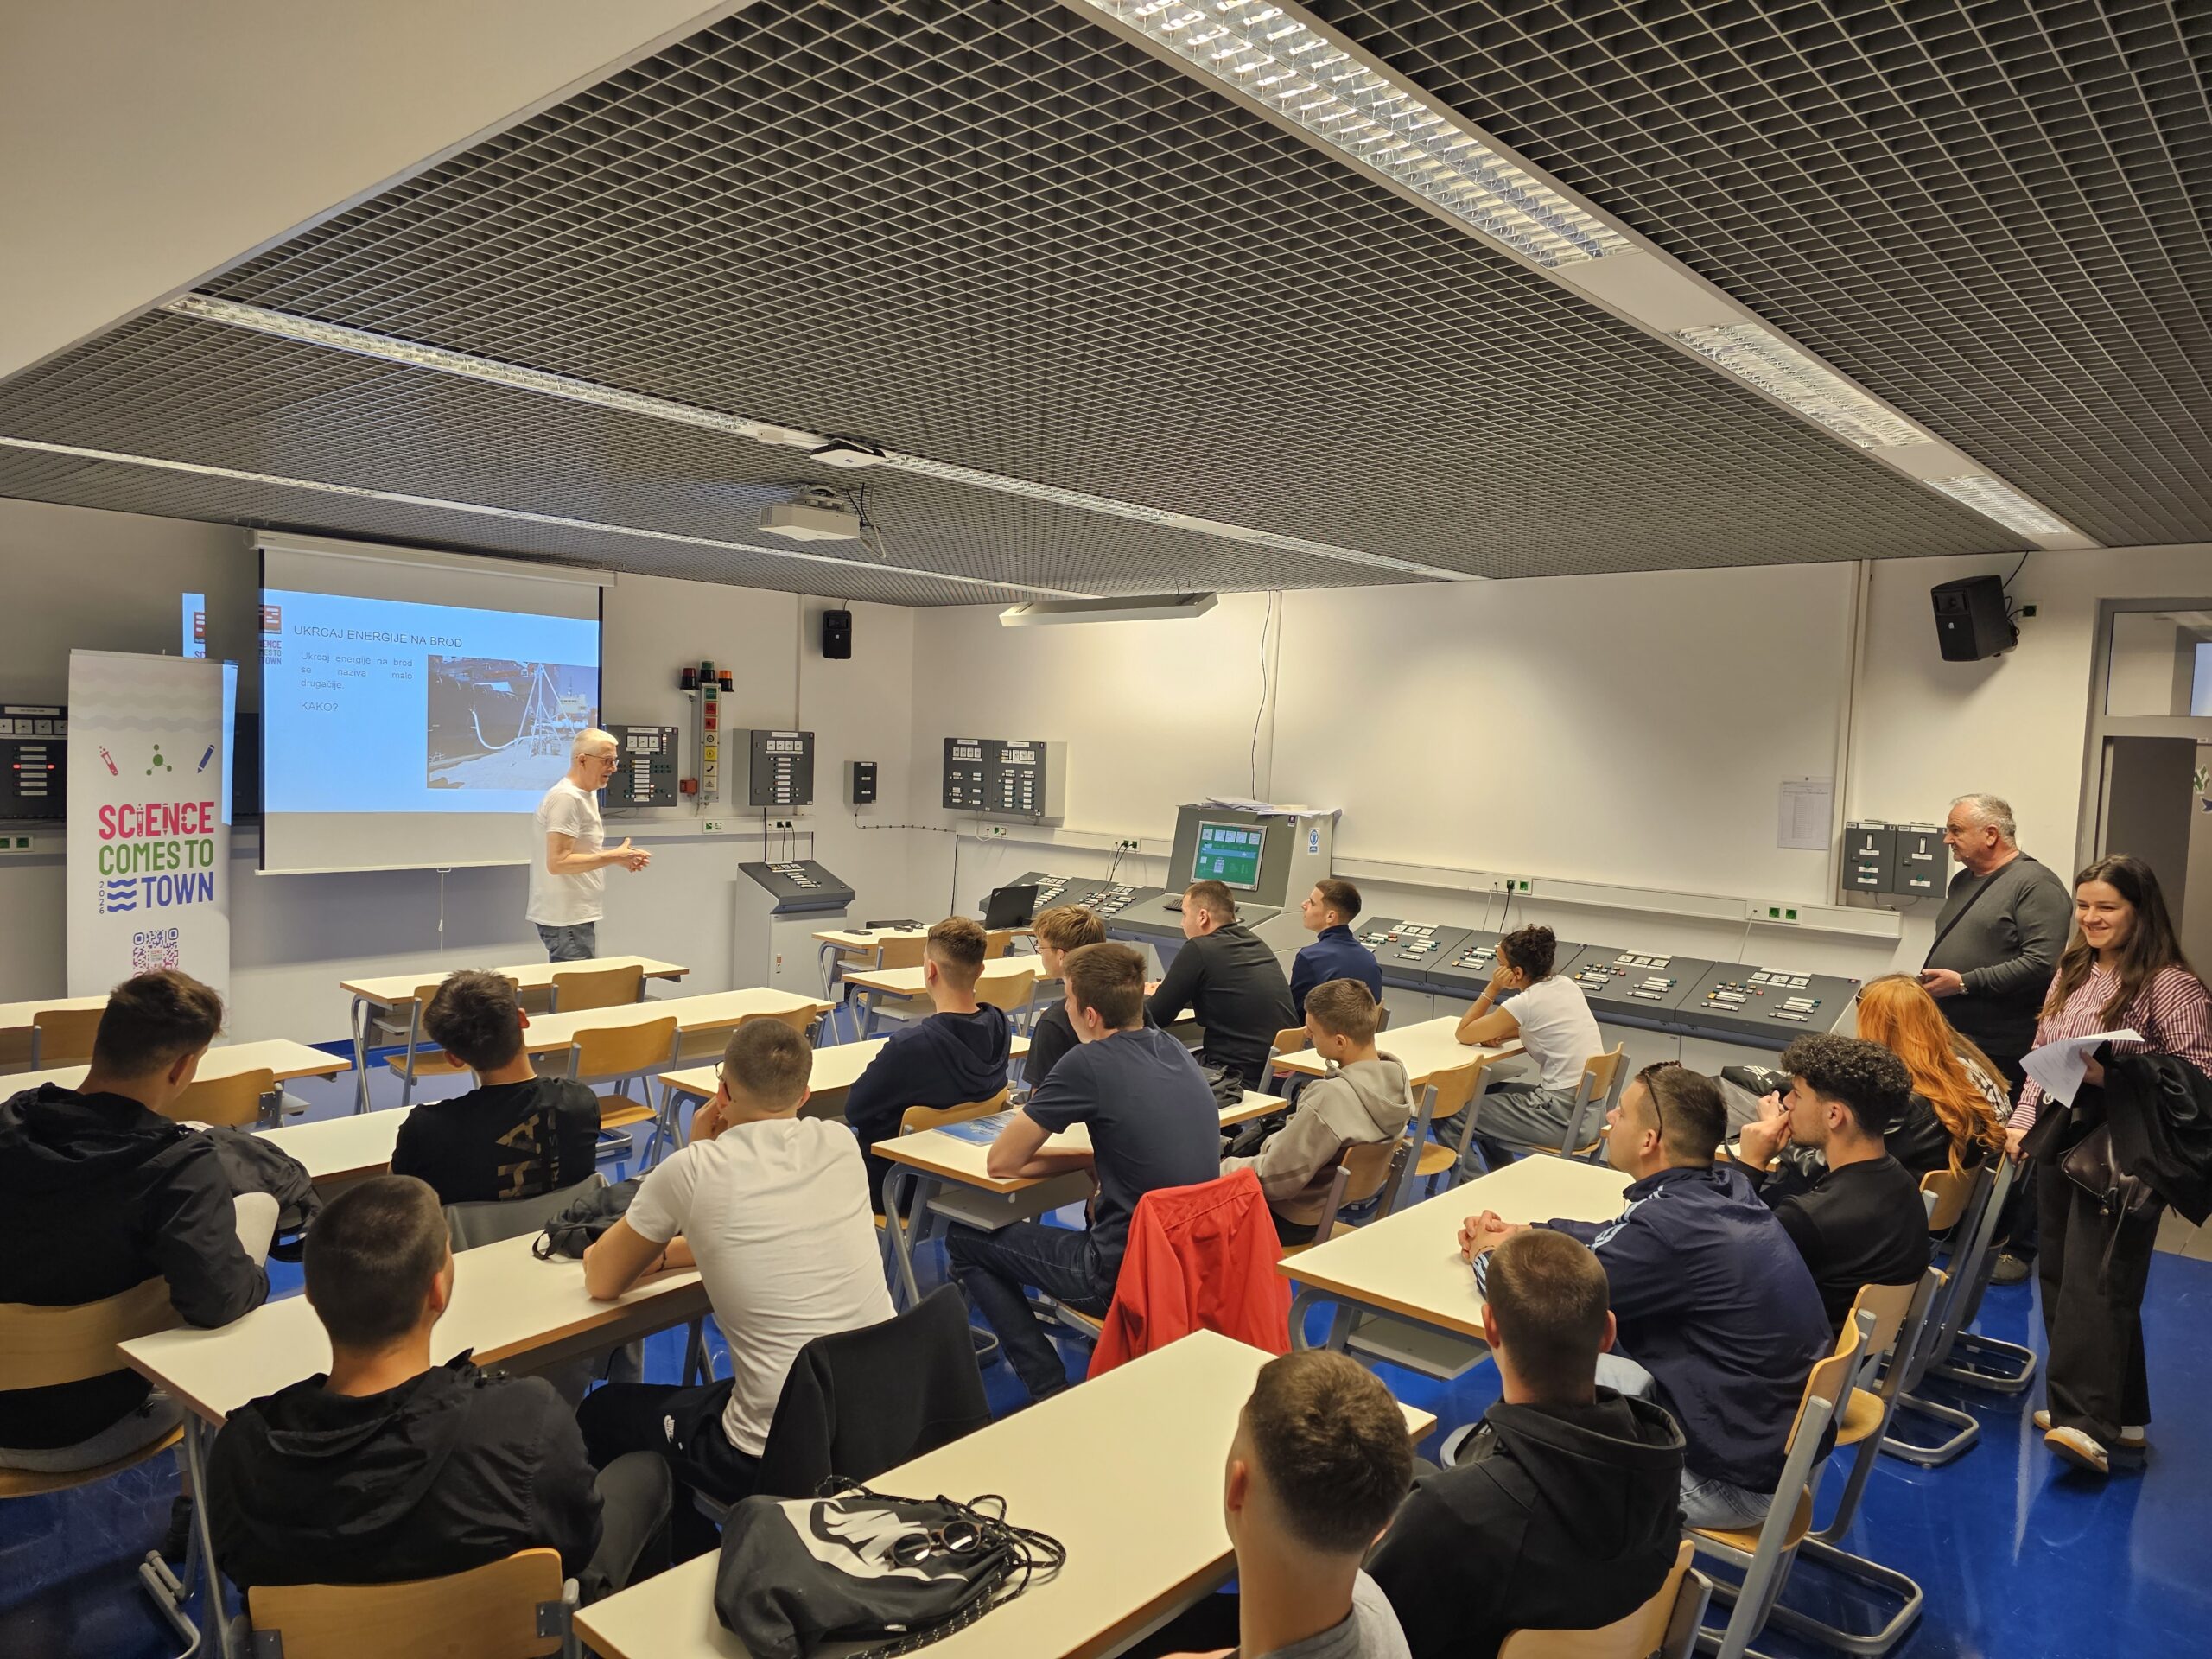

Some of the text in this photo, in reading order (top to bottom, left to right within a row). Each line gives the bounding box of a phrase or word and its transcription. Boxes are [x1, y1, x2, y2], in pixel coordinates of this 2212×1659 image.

[294, 625, 462, 648] UKRCAJ ENERGIJE NA BROD
[301, 652, 330, 663] Ukrcaj
[335, 655, 371, 666] energije
[393, 658, 413, 667] brod
[338, 667, 366, 677] naziva
[391, 671, 413, 680] malo
[301, 701, 339, 712] KAKO?
[99, 801, 215, 840] SCIENCE
[99, 838, 213, 875] COMES TO
[141, 871, 213, 908] TOWN
